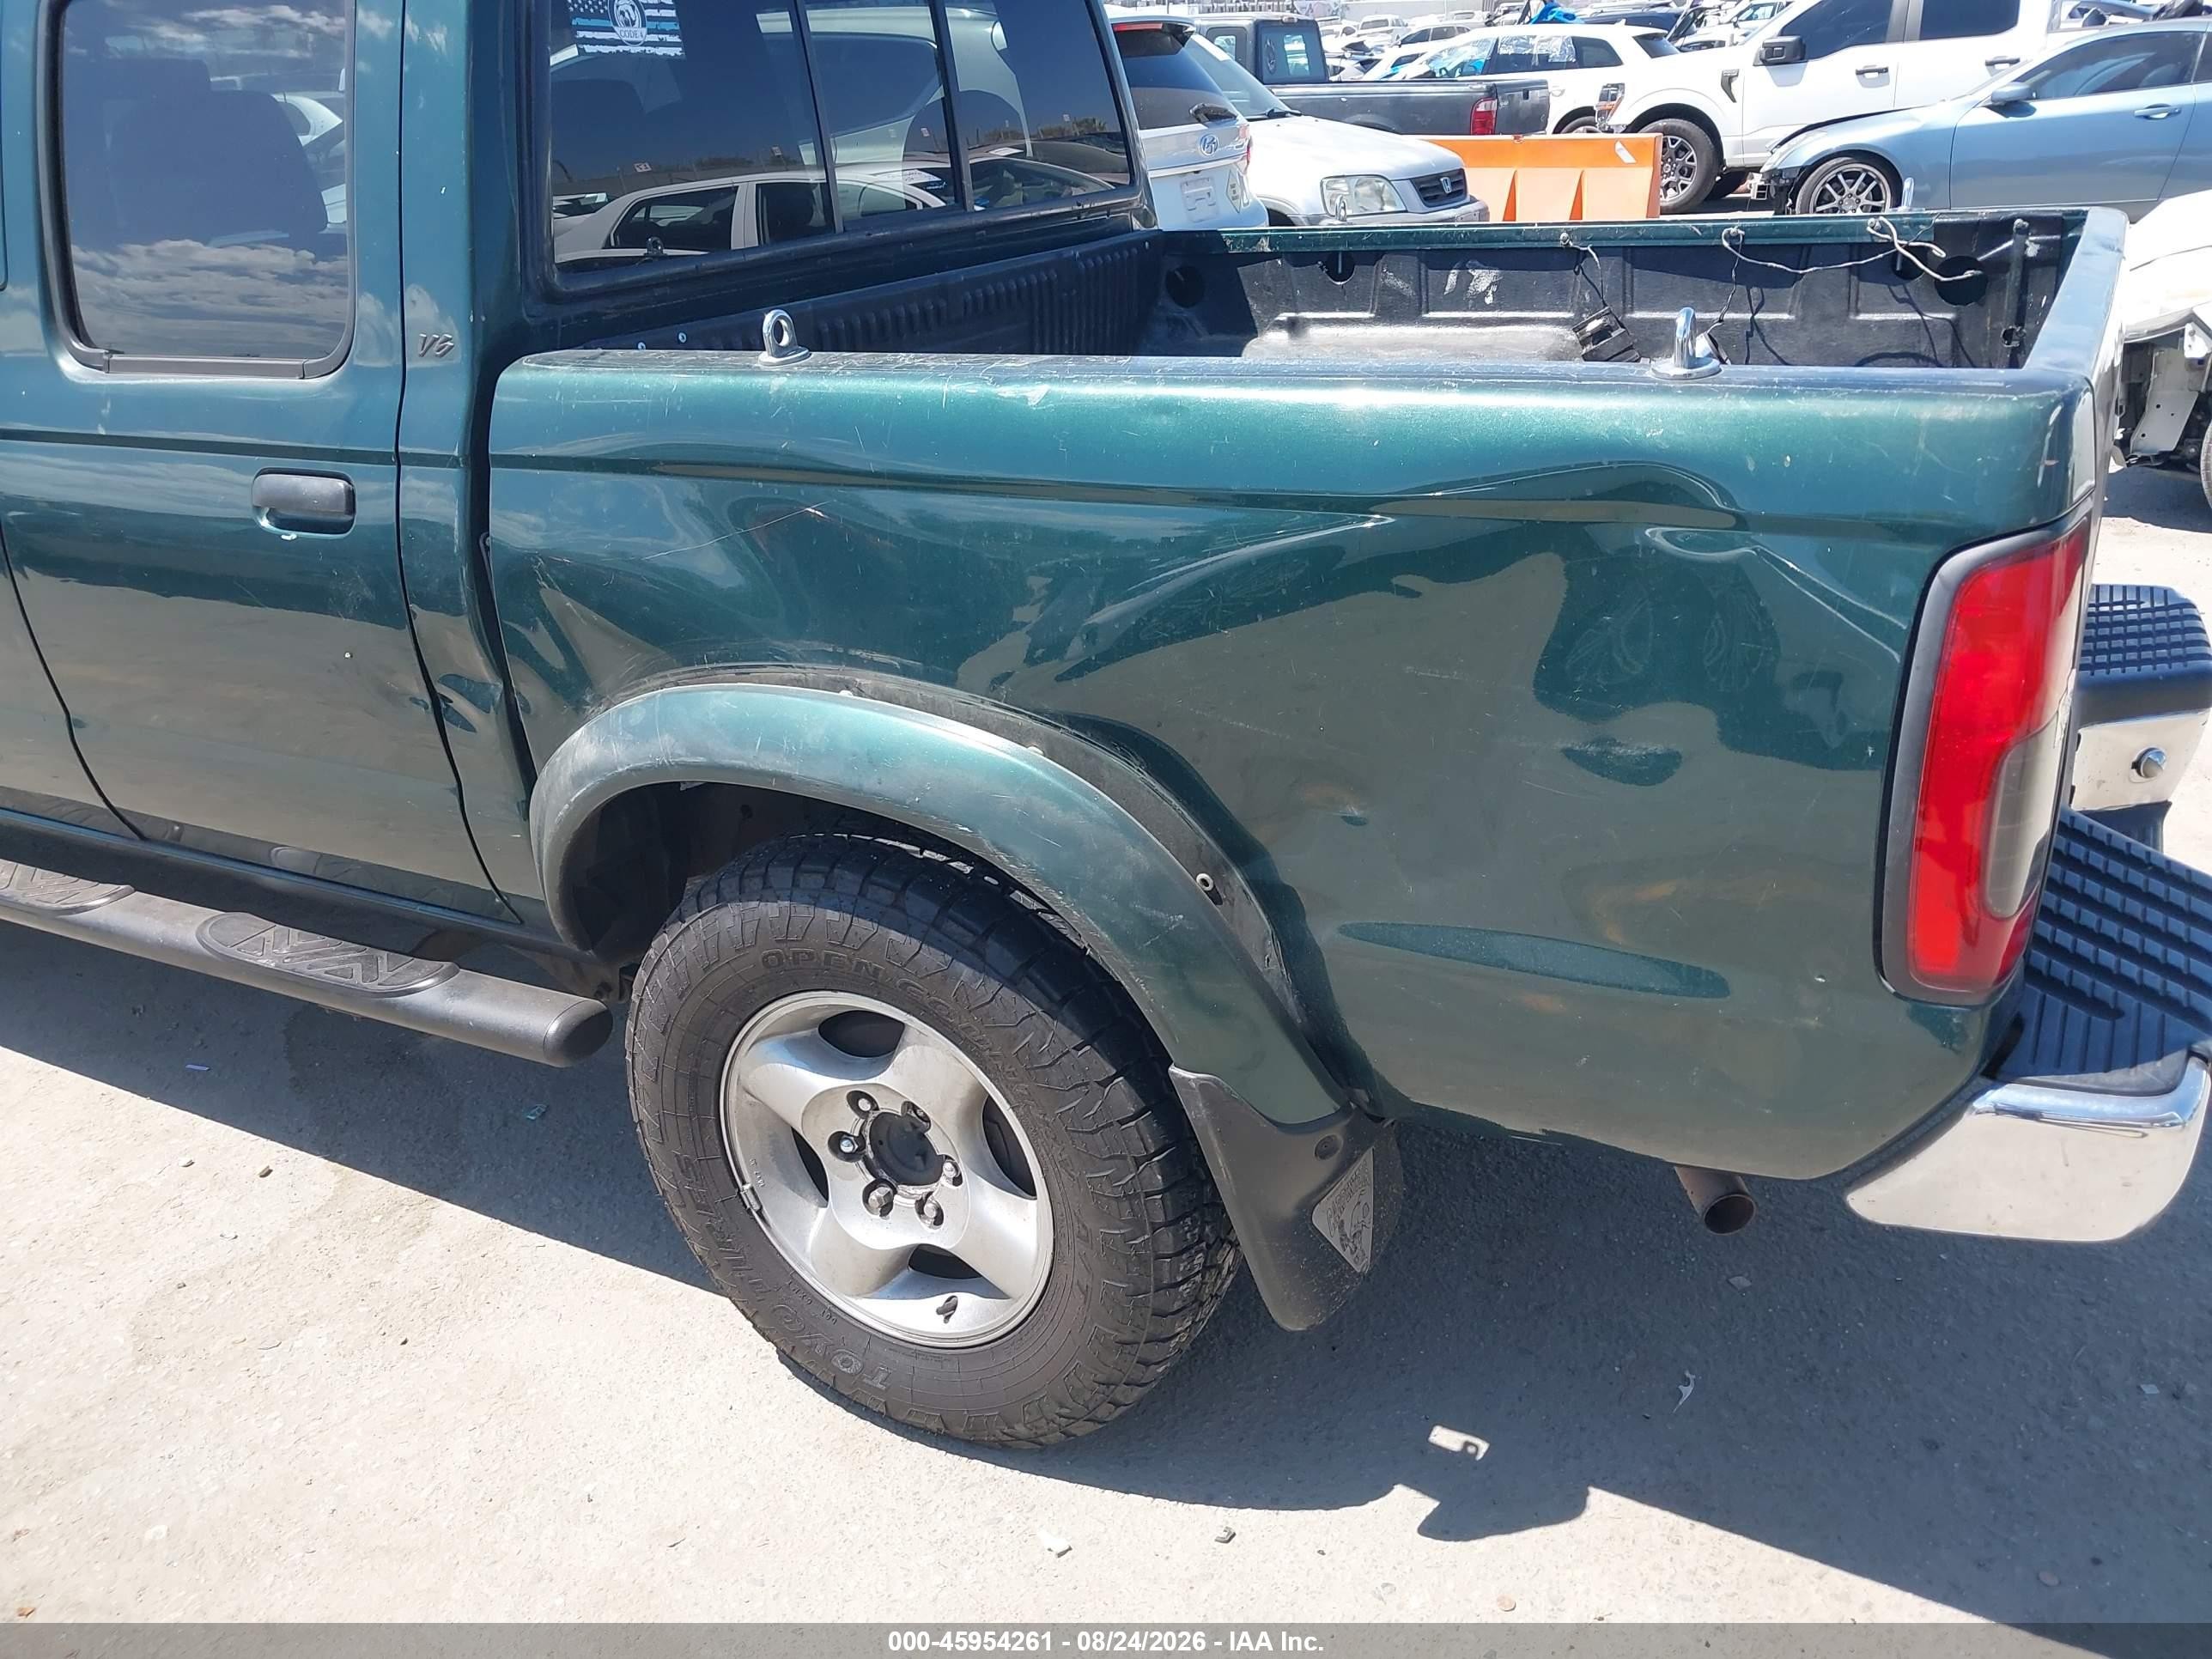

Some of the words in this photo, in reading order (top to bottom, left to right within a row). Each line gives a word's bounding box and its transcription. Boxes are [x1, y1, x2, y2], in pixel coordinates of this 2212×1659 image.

[620, 30, 639, 40] CODE
[418, 332, 455, 358] V6
[759, 945, 886, 981] OPEN
[766, 1297, 893, 1395] TOYO
